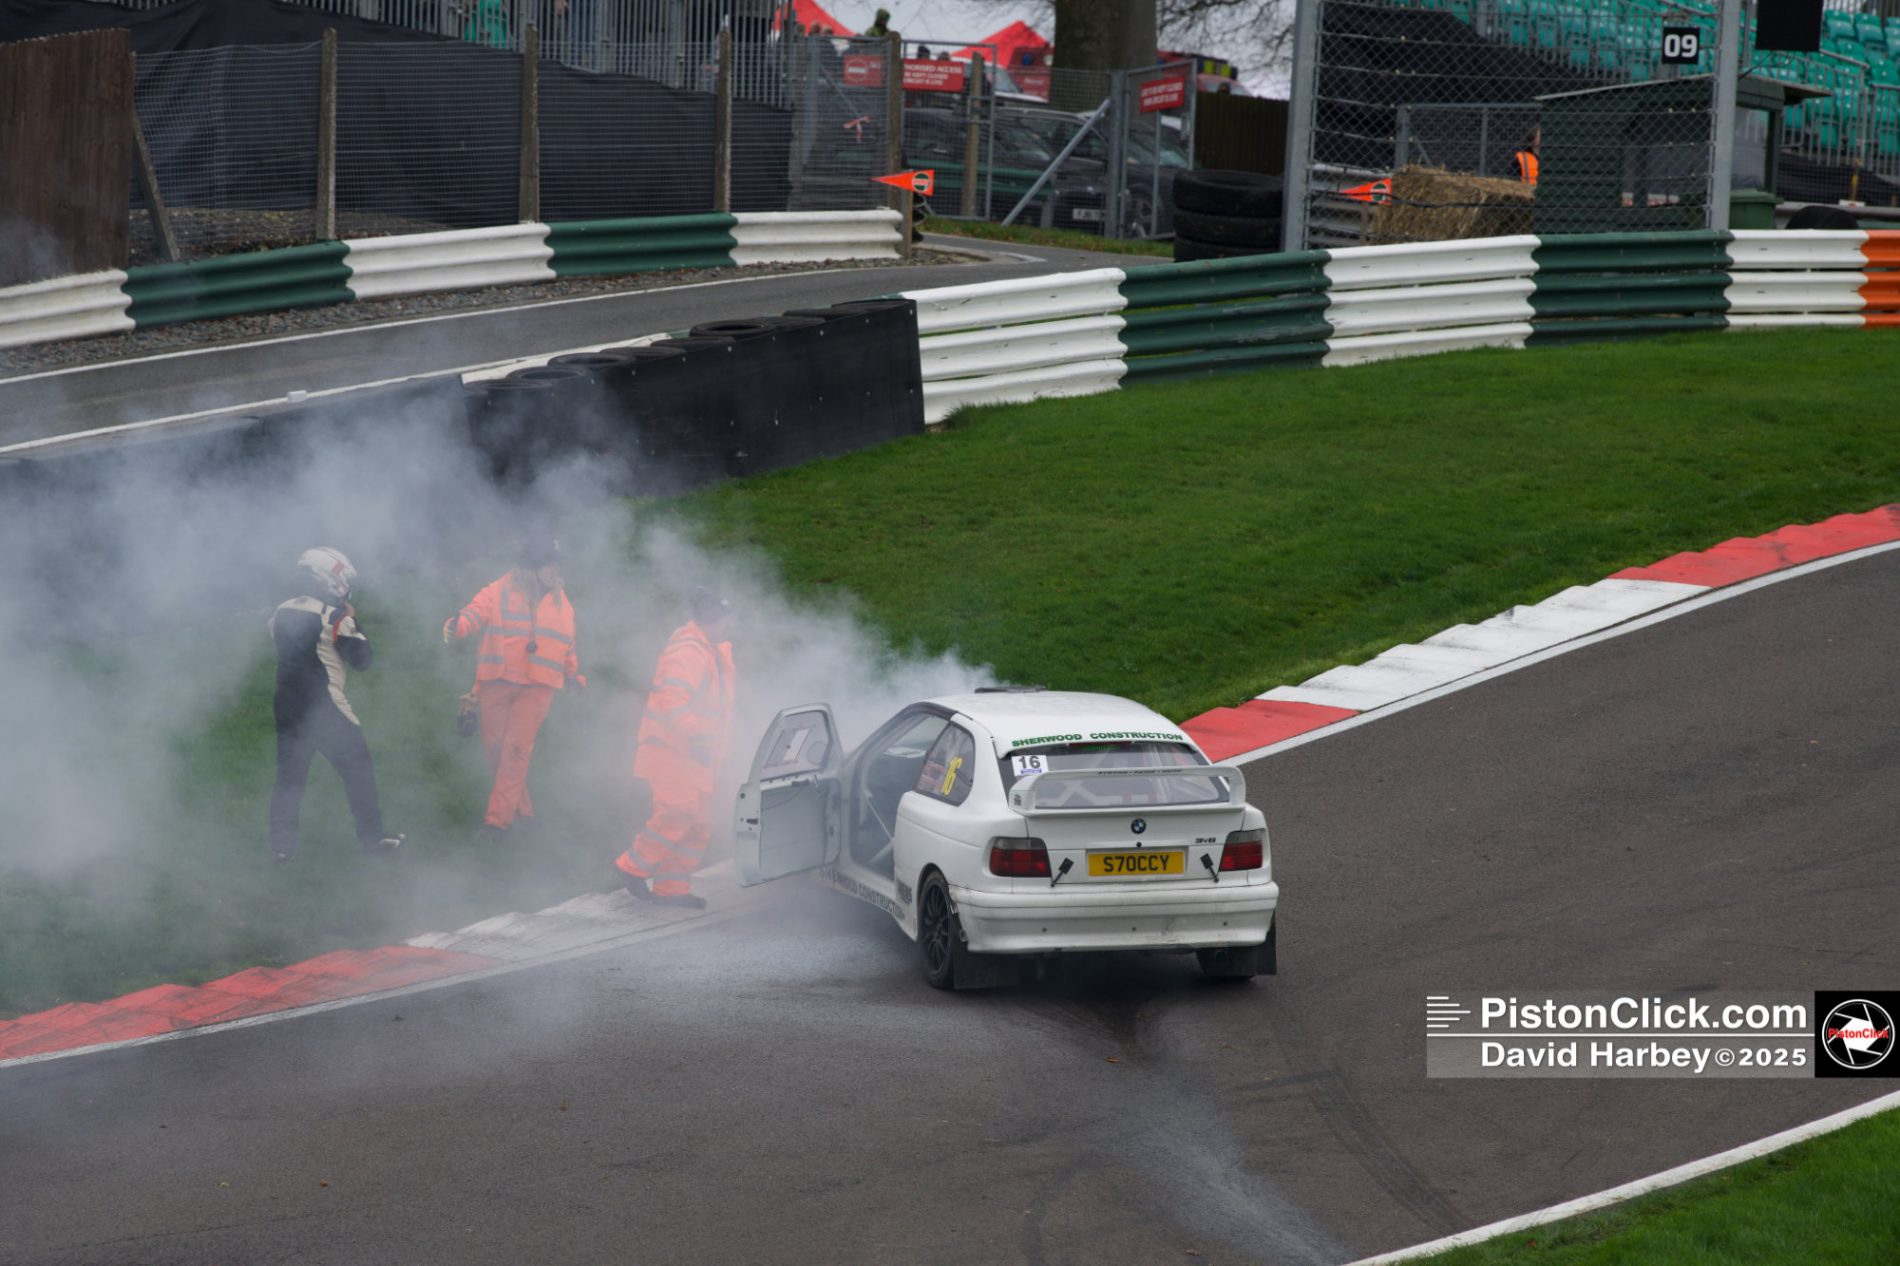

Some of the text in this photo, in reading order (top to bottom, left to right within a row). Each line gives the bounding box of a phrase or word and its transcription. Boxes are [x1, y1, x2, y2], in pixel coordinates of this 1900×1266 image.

[1664, 34, 1698, 58] 09
[1011, 731, 1184, 748] SHERWOOD CONSTRUCTION
[1018, 755, 1041, 769] 16
[942, 757, 962, 795] 16
